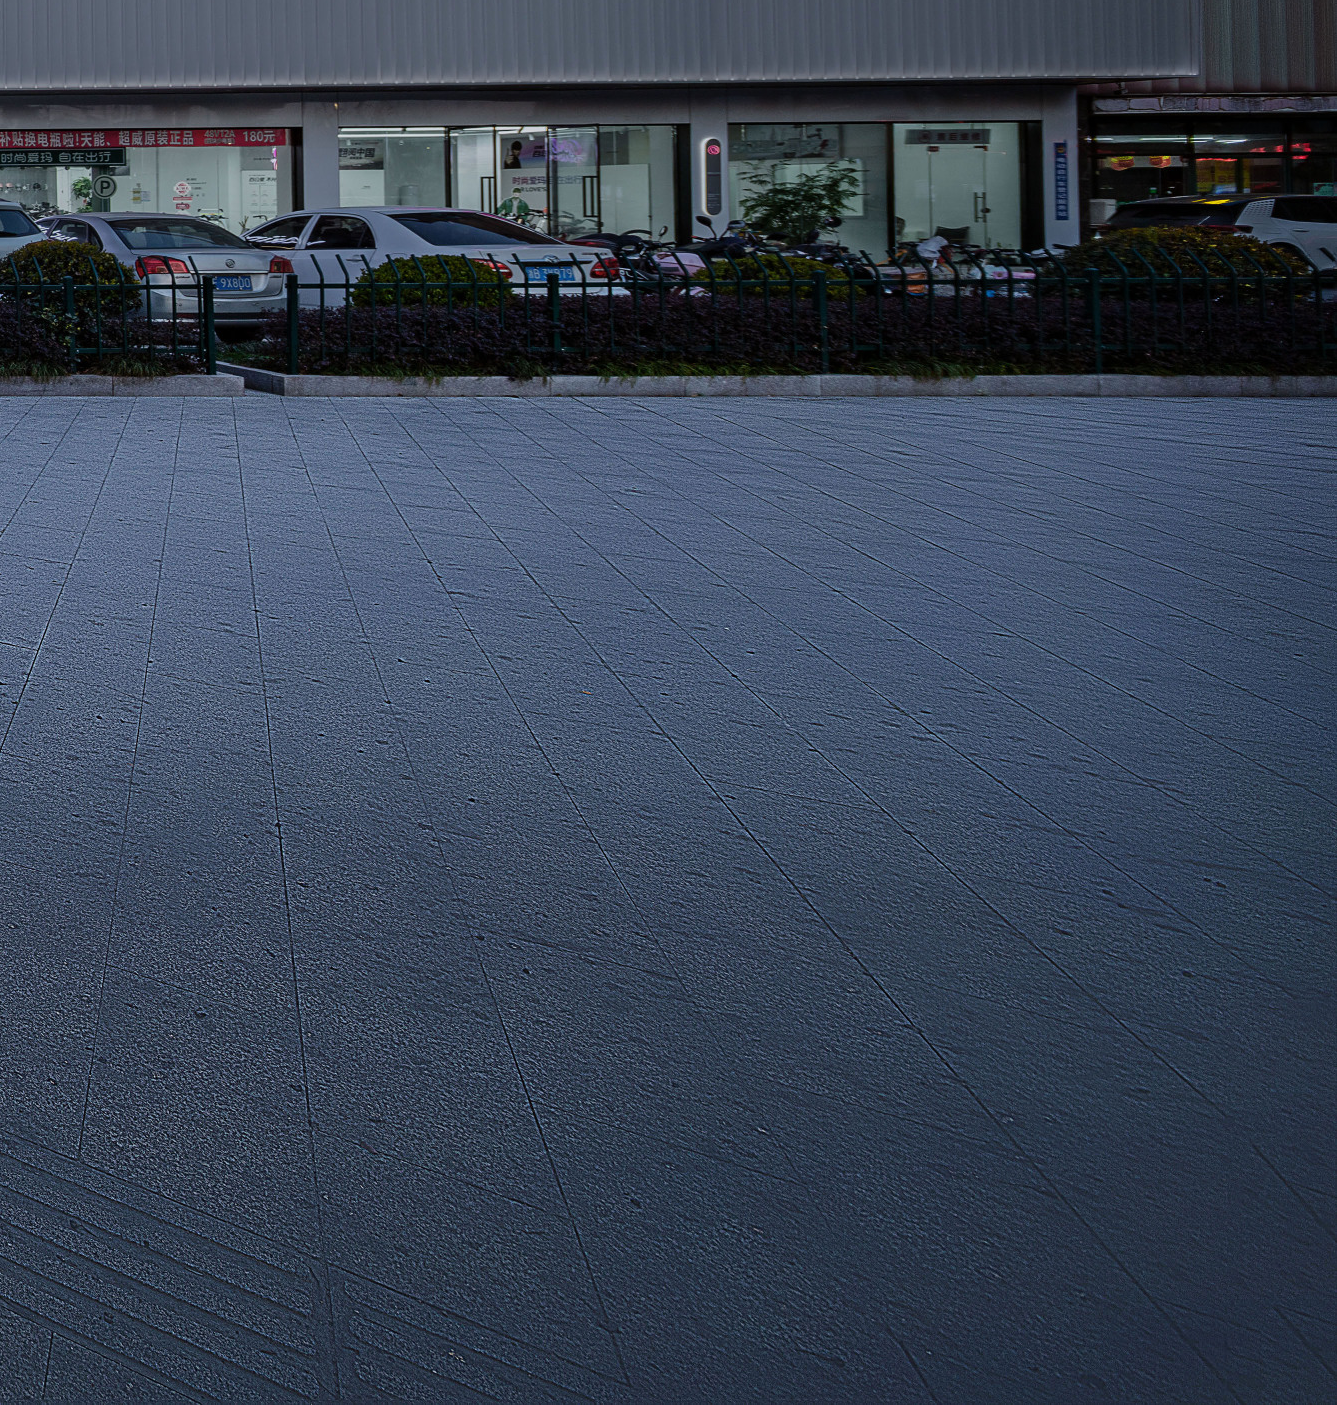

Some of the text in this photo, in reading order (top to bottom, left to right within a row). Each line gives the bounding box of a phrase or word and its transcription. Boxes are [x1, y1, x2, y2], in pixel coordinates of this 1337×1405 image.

[243, 130, 275, 142] 180元
[0, 151, 111, 163] 时尚爱玛 自在出行
